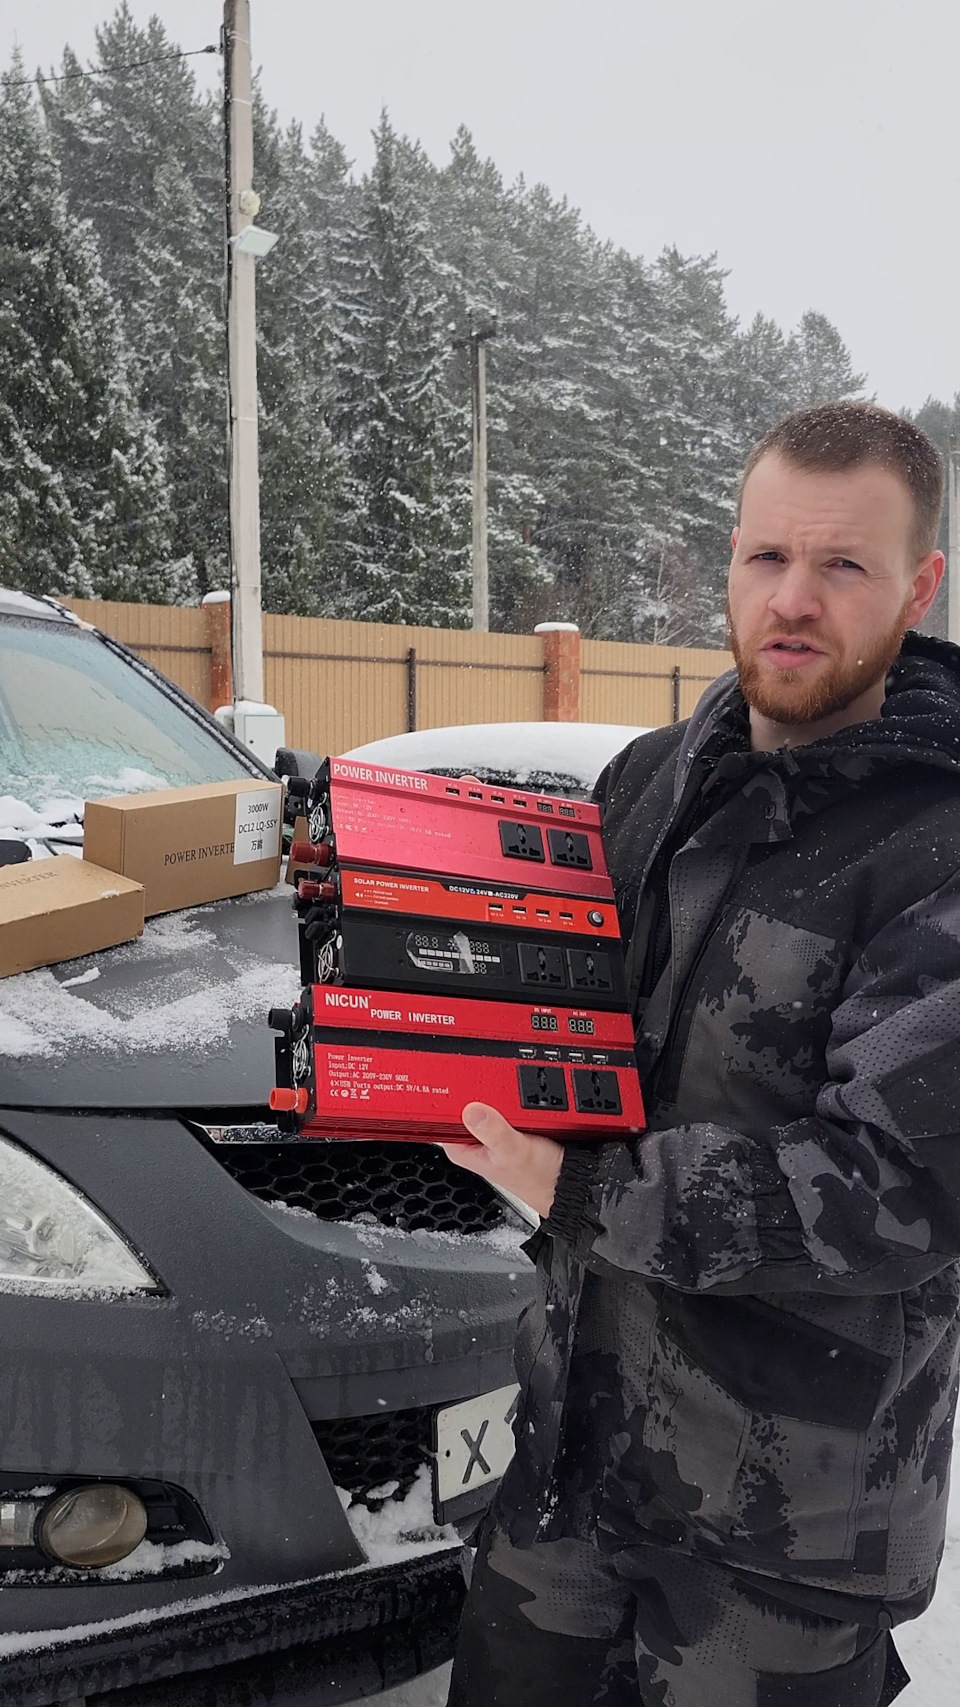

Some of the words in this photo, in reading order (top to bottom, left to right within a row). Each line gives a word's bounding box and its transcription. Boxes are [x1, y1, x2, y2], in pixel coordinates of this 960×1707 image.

[333, 763, 374, 781] POWER
[375, 770, 429, 790] INVERTER
[248, 802, 269, 814] 3000W
[256, 818, 278, 832] LQ-SSY
[164, 850, 196, 866] POWER
[198, 842, 236, 860] INVERTE
[354, 878, 375, 886] SOLAR
[376, 880, 398, 888] POWER
[400, 884, 430, 892] INVERTER
[325, 992, 369, 1009] NICUN
[370, 1008, 402, 1020] POWER
[408, 1012, 455, 1025] INVERTER
[328, 1052, 344, 1060] Power
[348, 1054, 373, 1062] Inverter
[328, 1061, 356, 1070] Input:DC
[328, 1070, 360, 1079] Output:AC
[432, 1087, 448, 1095] rated
